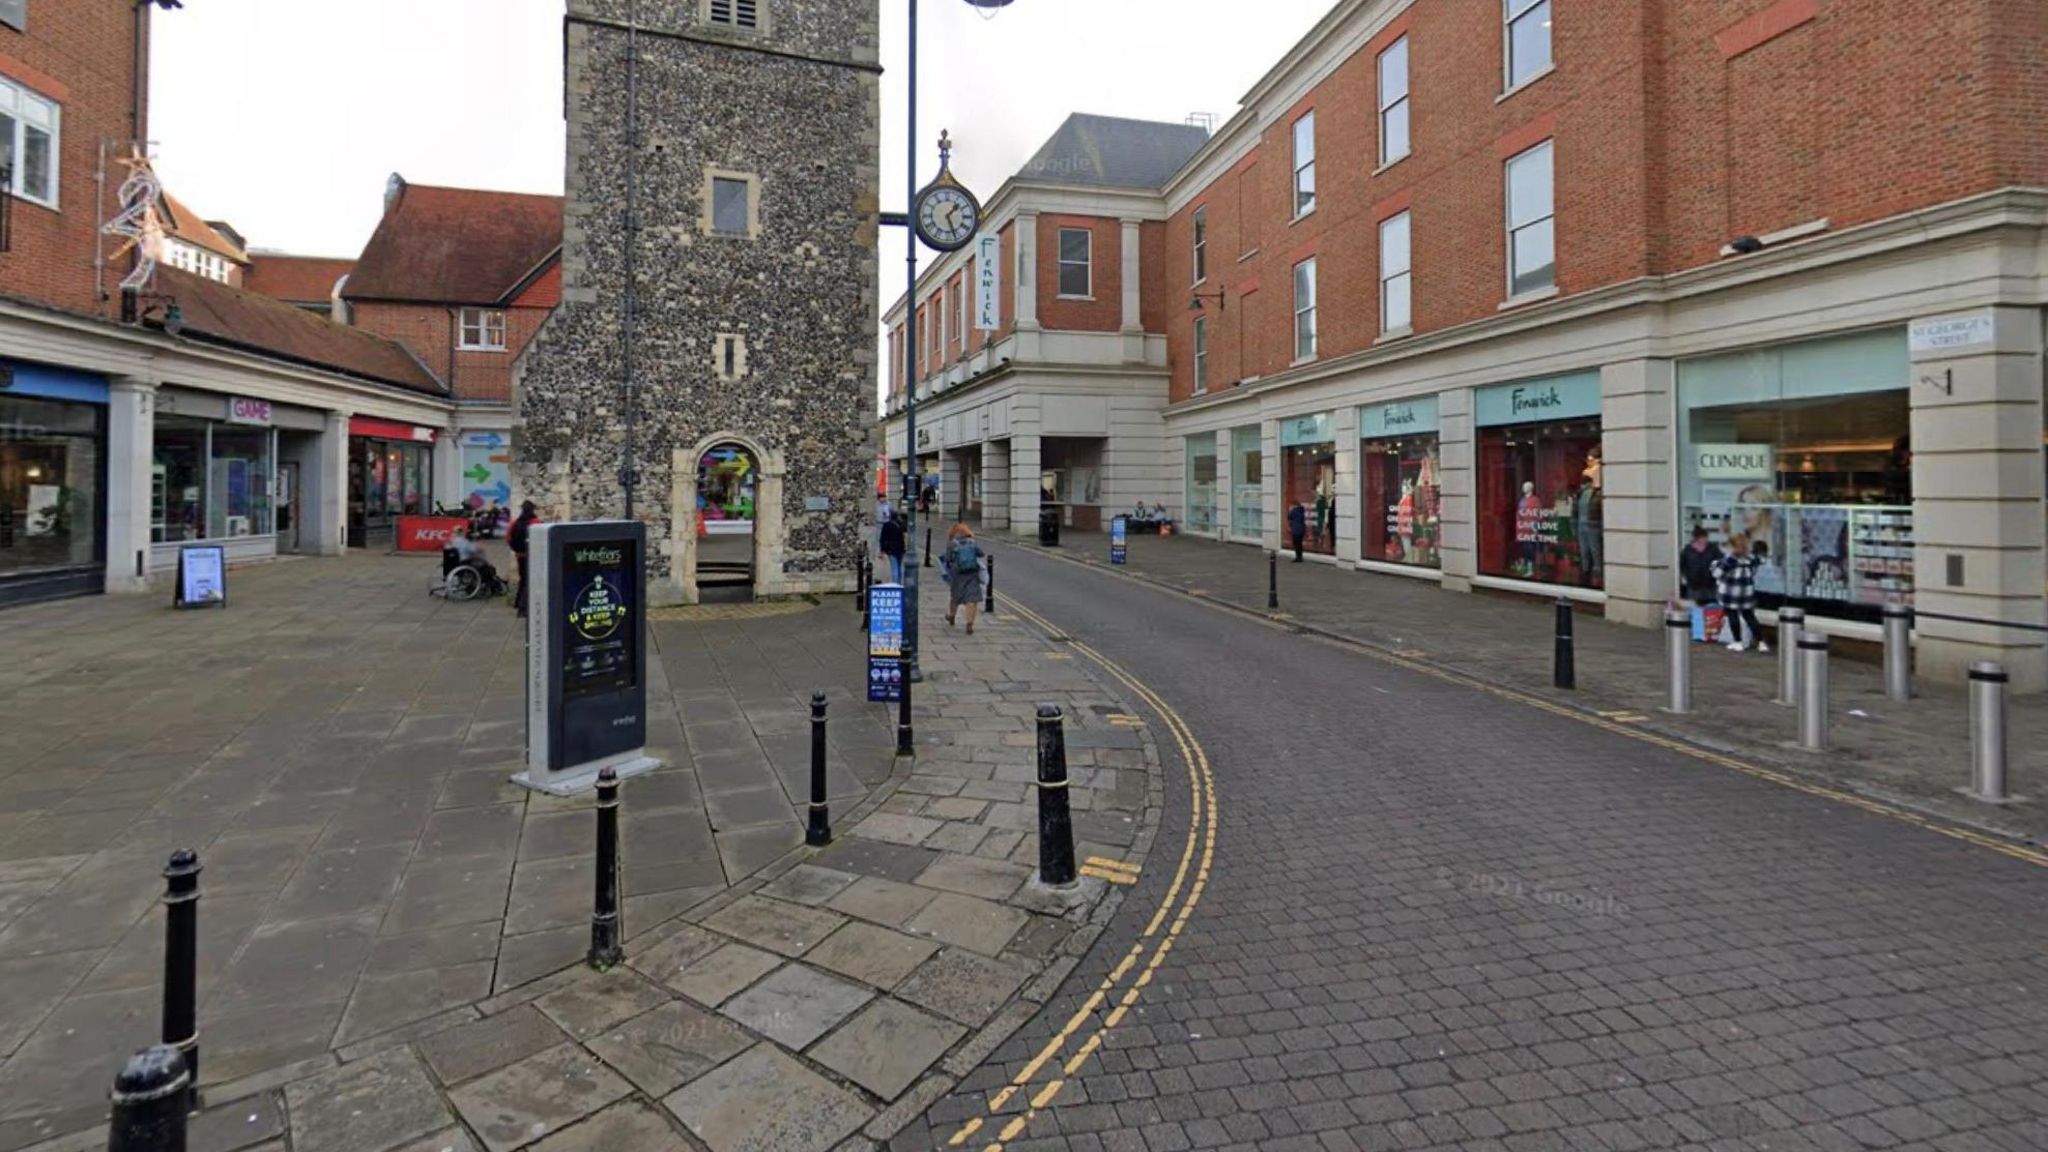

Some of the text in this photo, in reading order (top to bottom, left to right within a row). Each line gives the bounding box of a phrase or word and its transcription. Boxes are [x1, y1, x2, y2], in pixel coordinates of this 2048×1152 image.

[981, 237, 996, 325] Fenwick
[1511, 385, 1562, 416] Fenwick
[234, 399, 271, 422] GAME
[1383, 406, 1416, 430] Fenwick
[1699, 453, 1768, 471] CLINIQUE
[1537, 521, 1559, 531] LOVE
[415, 529, 450, 540] KFC
[1538, 533, 1559, 544] TIME
[872, 590, 901, 598] PLEASE
[872, 597, 901, 607] KEEP
